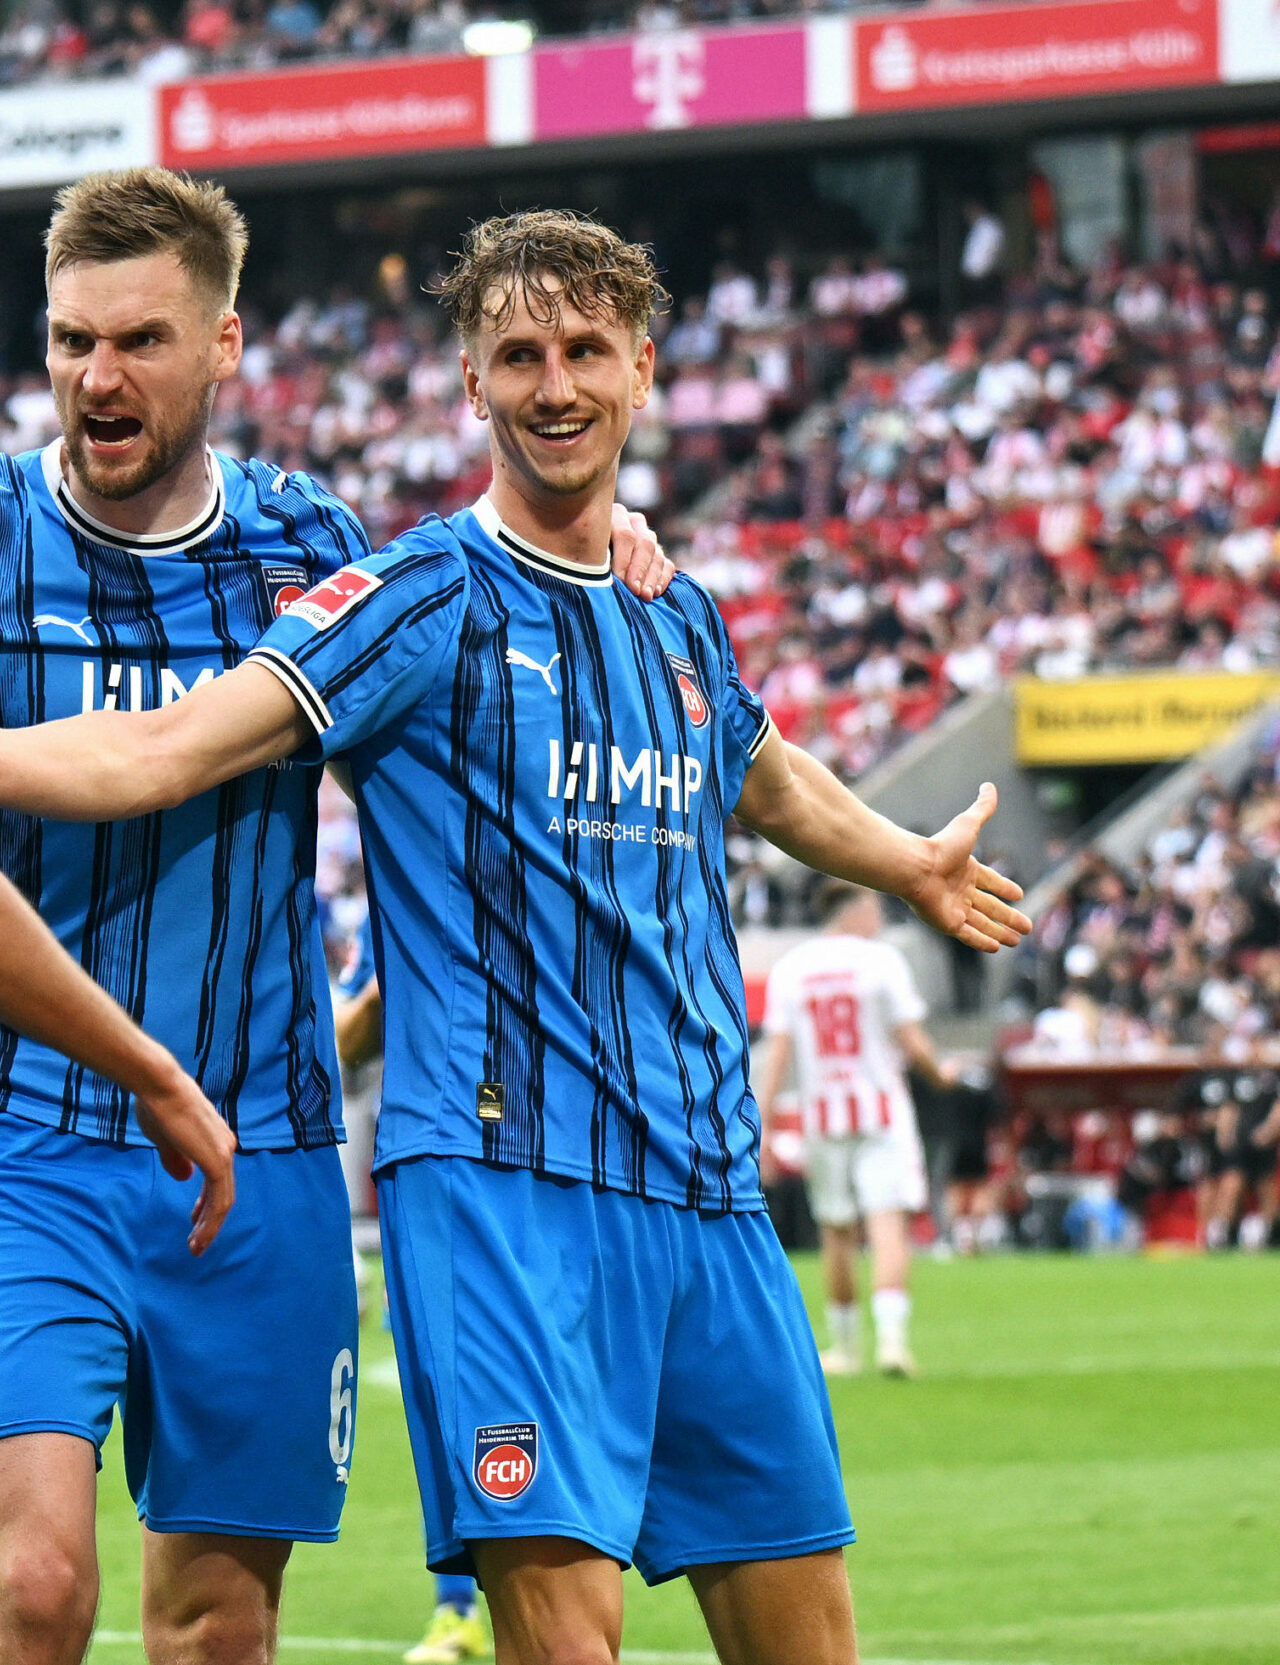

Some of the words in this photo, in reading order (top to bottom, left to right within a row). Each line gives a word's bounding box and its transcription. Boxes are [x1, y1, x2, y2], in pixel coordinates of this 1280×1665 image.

[611, 746, 702, 814] MHP
[547, 816, 561, 834] A
[567, 818, 647, 843] PORSCHE
[807, 994, 861, 1058] 18
[329, 1348, 353, 1465] 6
[486, 1459, 525, 1483] FCH
